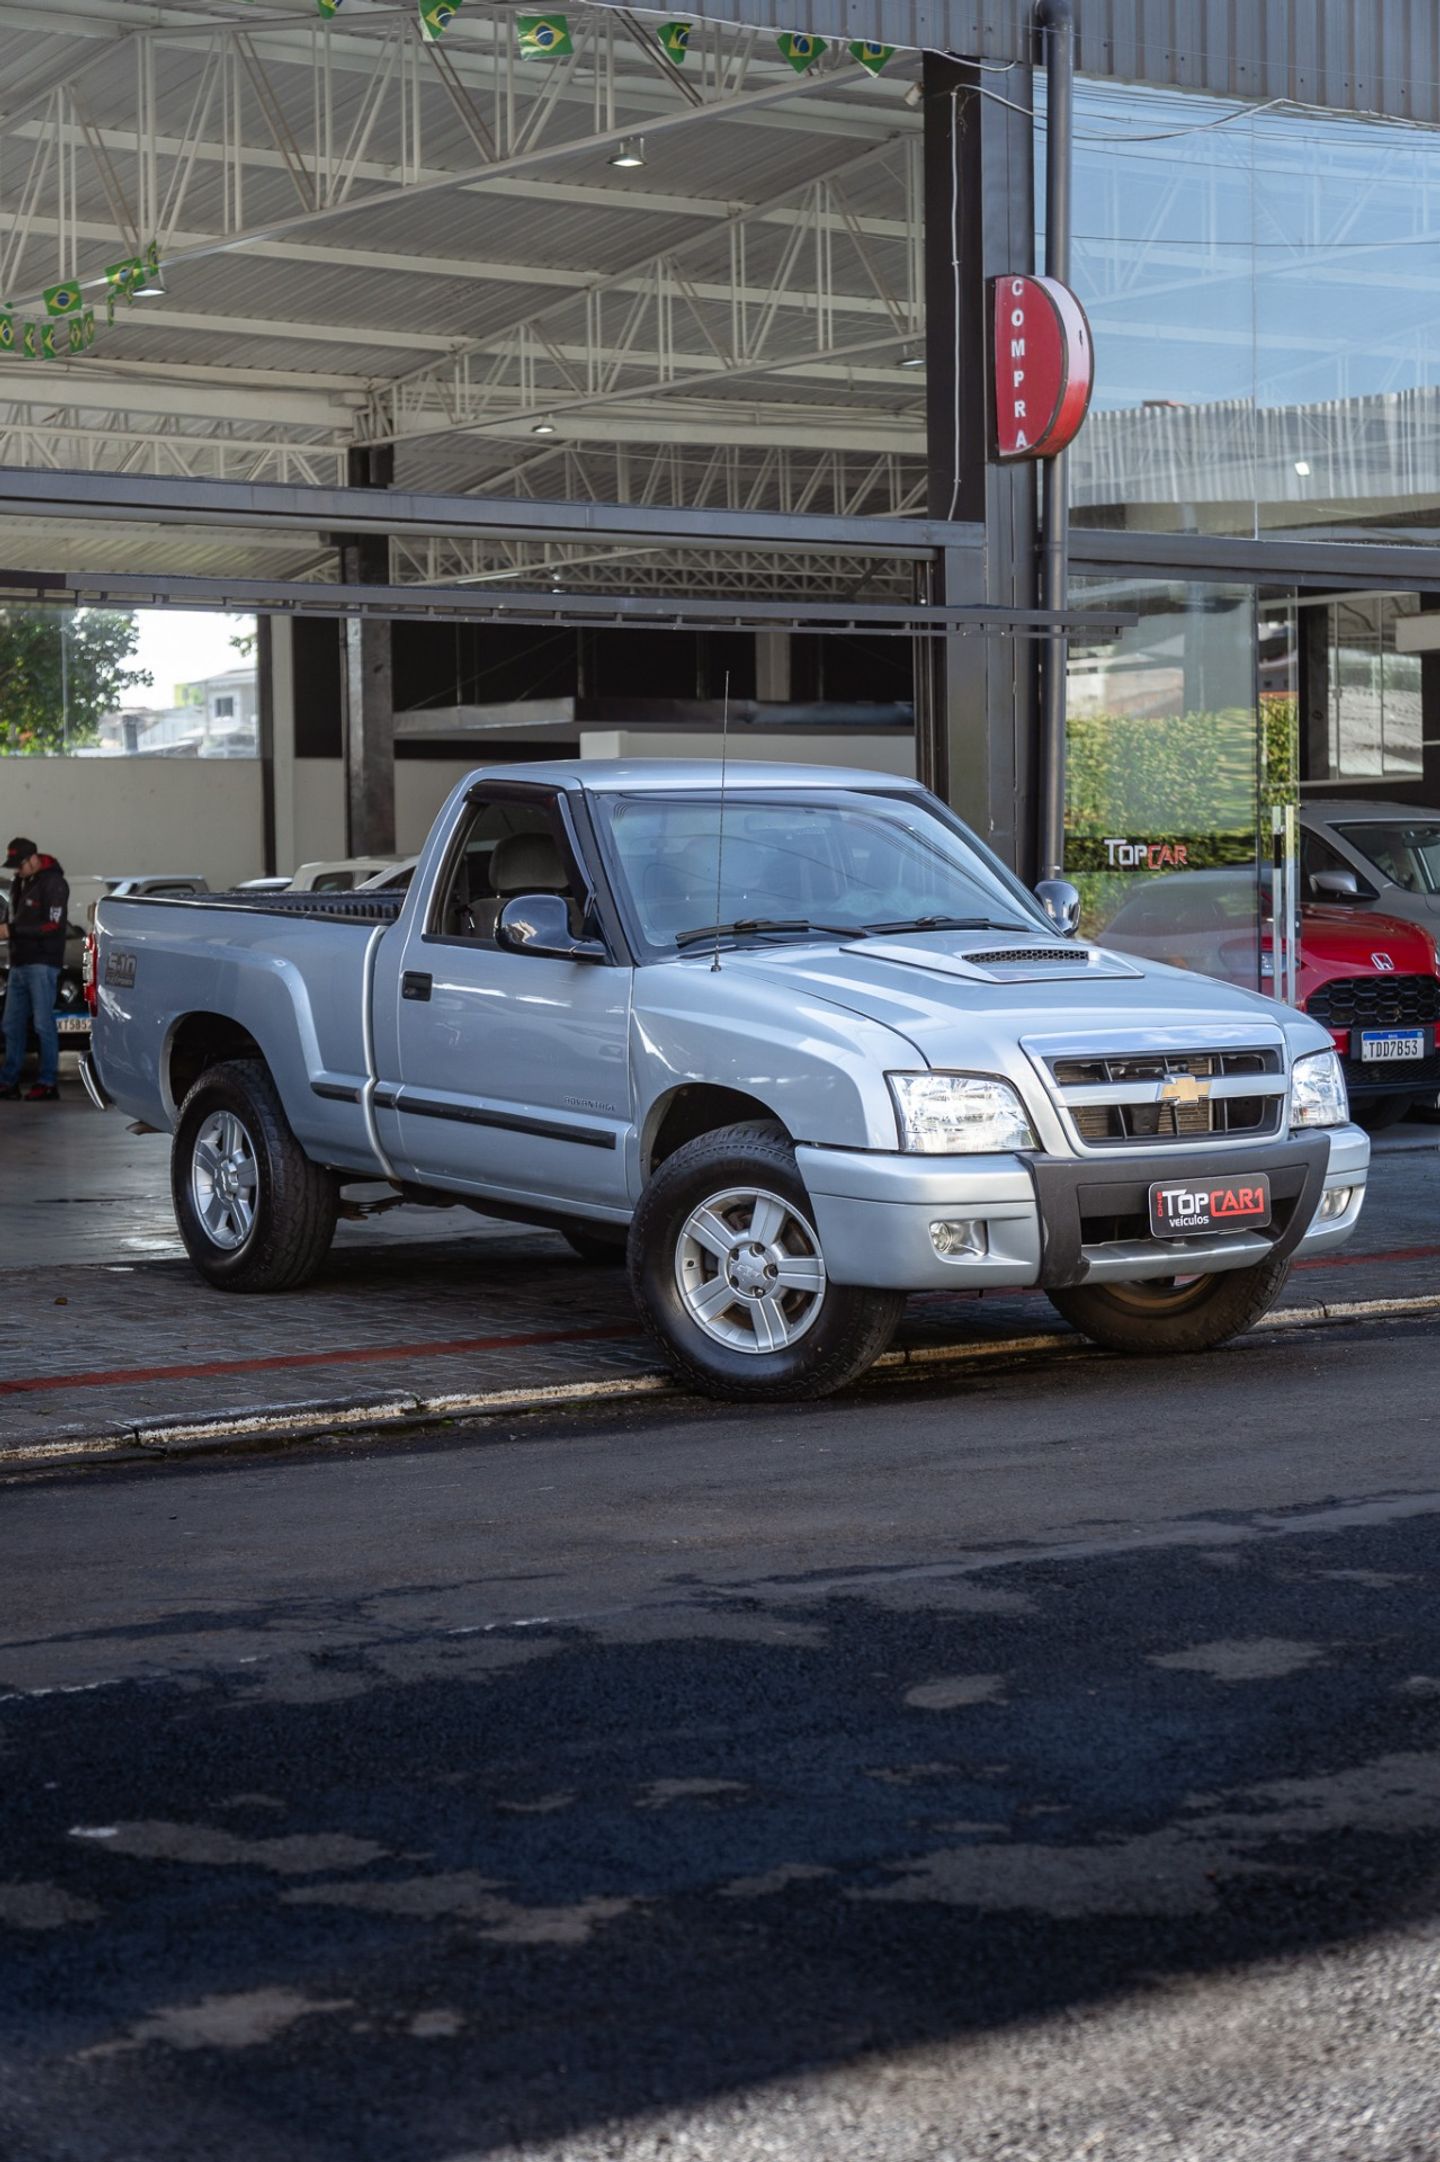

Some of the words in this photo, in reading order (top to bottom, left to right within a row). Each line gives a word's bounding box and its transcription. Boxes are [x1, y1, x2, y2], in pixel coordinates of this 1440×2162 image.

[1011, 279, 1028, 449] COMPRA
[1369, 1040, 1418, 1058] TDD7B53
[1169, 1214, 1210, 1228] veículos
